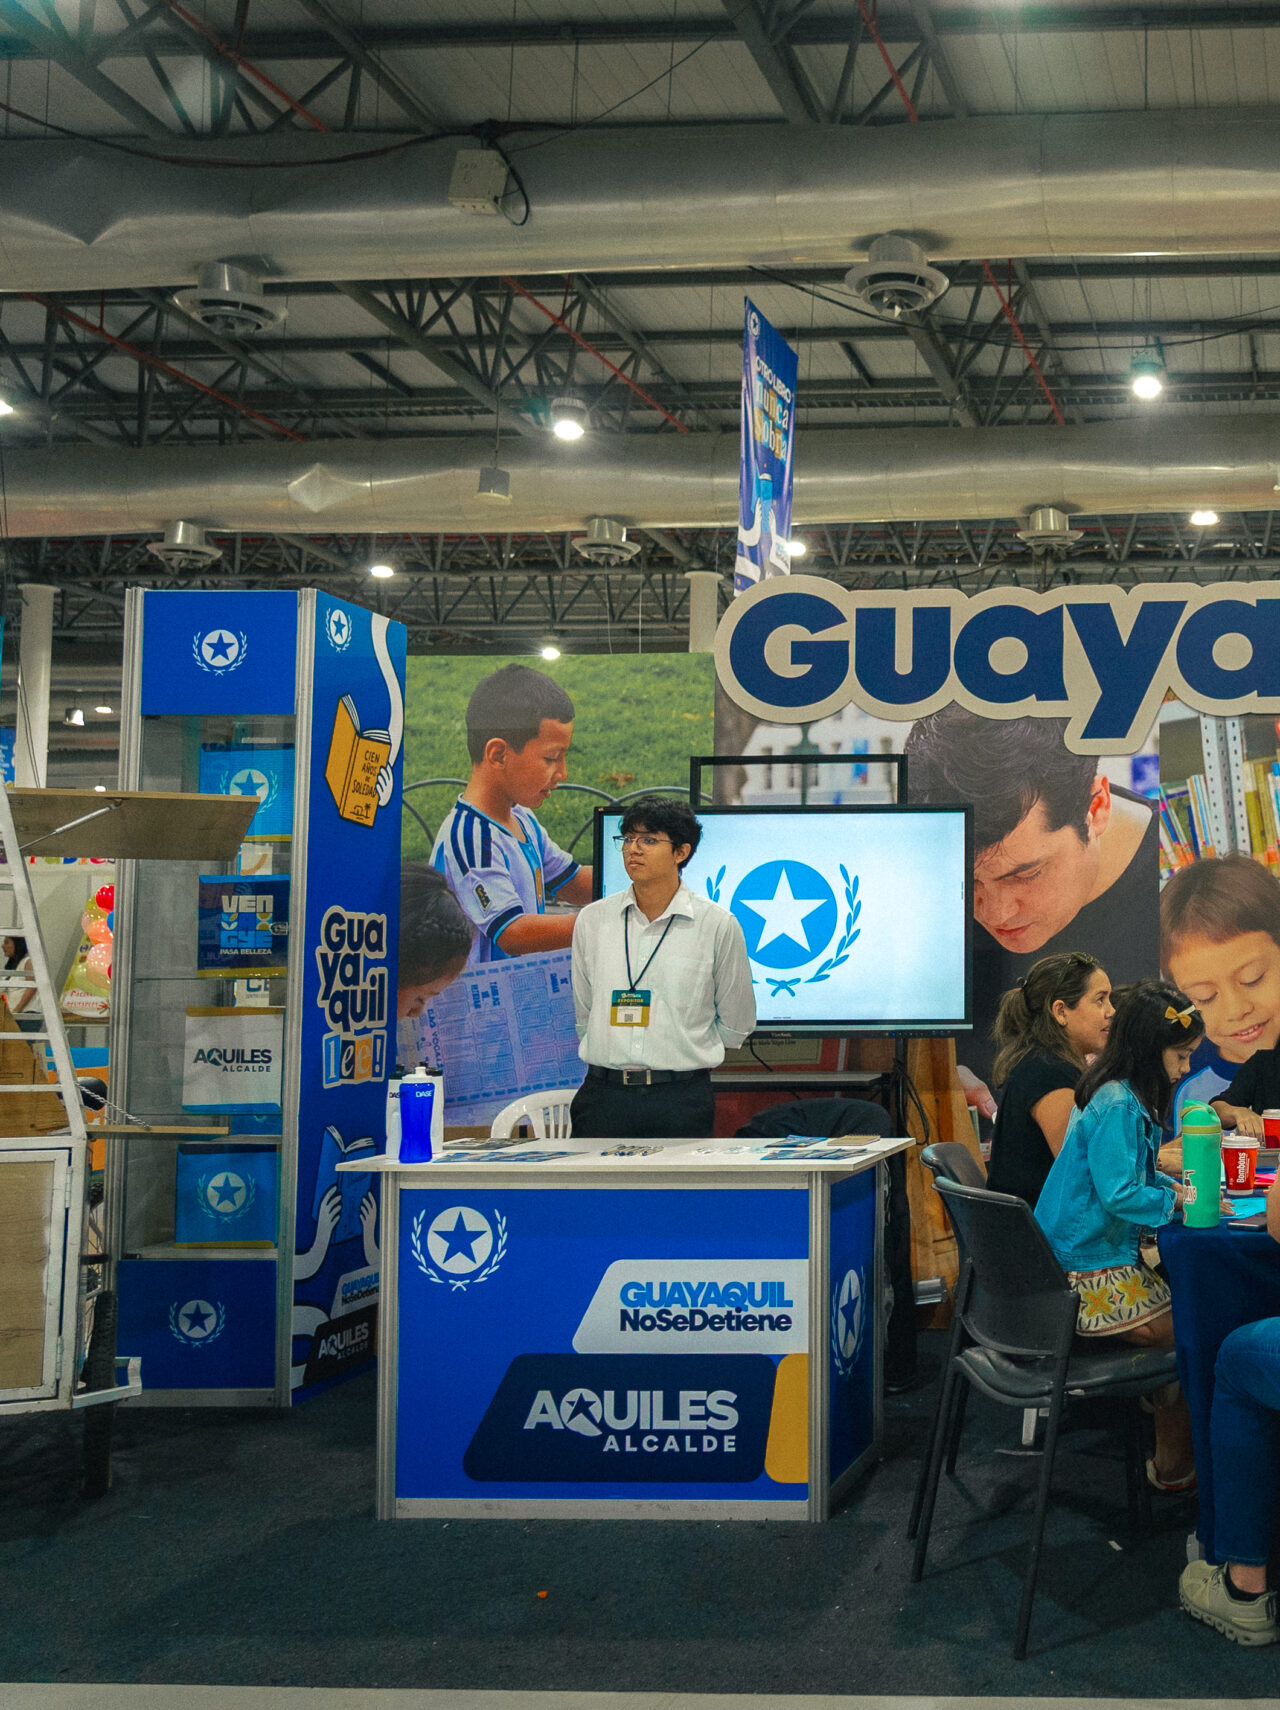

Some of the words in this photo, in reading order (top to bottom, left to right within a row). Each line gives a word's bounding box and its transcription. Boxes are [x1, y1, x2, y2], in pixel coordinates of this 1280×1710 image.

[756, 356, 773, 385] OTRO
[773, 373, 791, 404] LIBRO
[755, 379, 789, 431] nunca
[365, 750, 380, 763] CIEN
[324, 912, 384, 952] Gua
[320, 952, 361, 1000] ya
[328, 973, 385, 1032] quil
[194, 1048, 273, 1067] AQUILES
[328, 1038, 382, 1078] lee!
[389, 1091, 401, 1099] DAS
[415, 1090, 432, 1098] DASE
[620, 1281, 793, 1309] GUAYAQUIL
[620, 1307, 793, 1332] NoSeDetiene
[318, 1322, 368, 1360] AQUILES
[524, 1388, 739, 1436] AQUILES
[602, 1435, 737, 1453] ALCALDE
